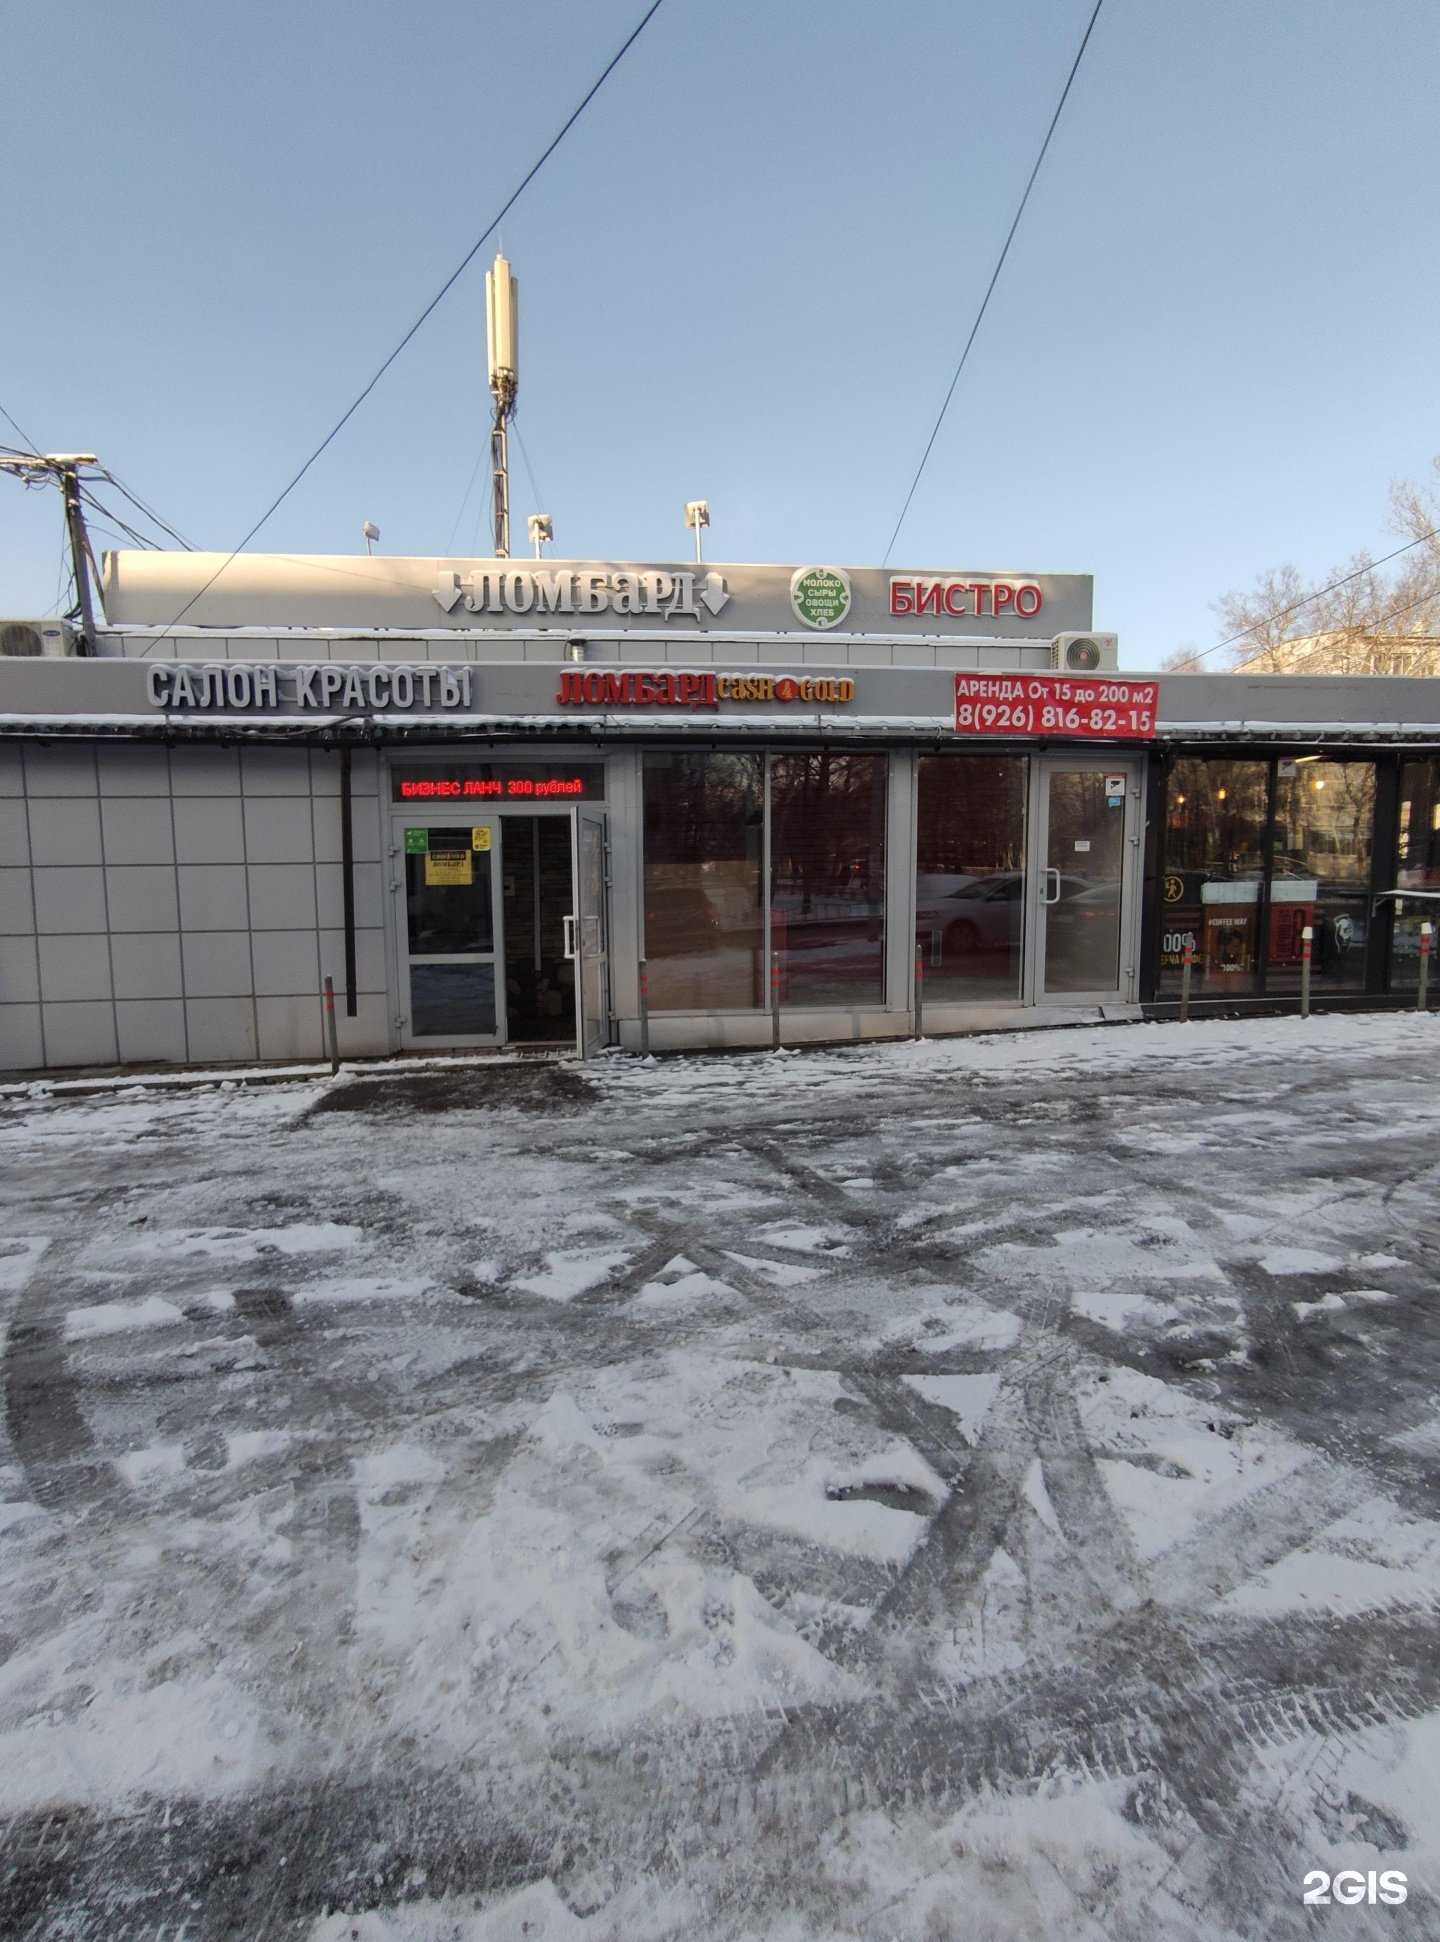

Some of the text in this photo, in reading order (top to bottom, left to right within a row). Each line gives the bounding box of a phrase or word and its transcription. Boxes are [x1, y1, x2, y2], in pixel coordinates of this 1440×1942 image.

[803, 579, 841, 587] МОЛОКО
[808, 589, 836, 597] СЫРЫ
[889, 579, 1043, 618] БИСТРО
[805, 599, 839, 607] ОВОЩИ
[810, 608, 834, 617] ХЛЕБ
[148, 665, 472, 708] САЛОН КРАСОТЫ
[957, 679, 1025, 700] АРЕНДА
[1054, 683, 1071, 700] 15
[1074, 688, 1096, 702] до
[1099, 686, 1129, 703] 200
[1132, 688, 1154, 704] м2
[958, 703, 1151, 732] 8(926) 816-82-15
[401, 778, 582, 796] БИЗНЕС ЛАНЧ 300 рублей
